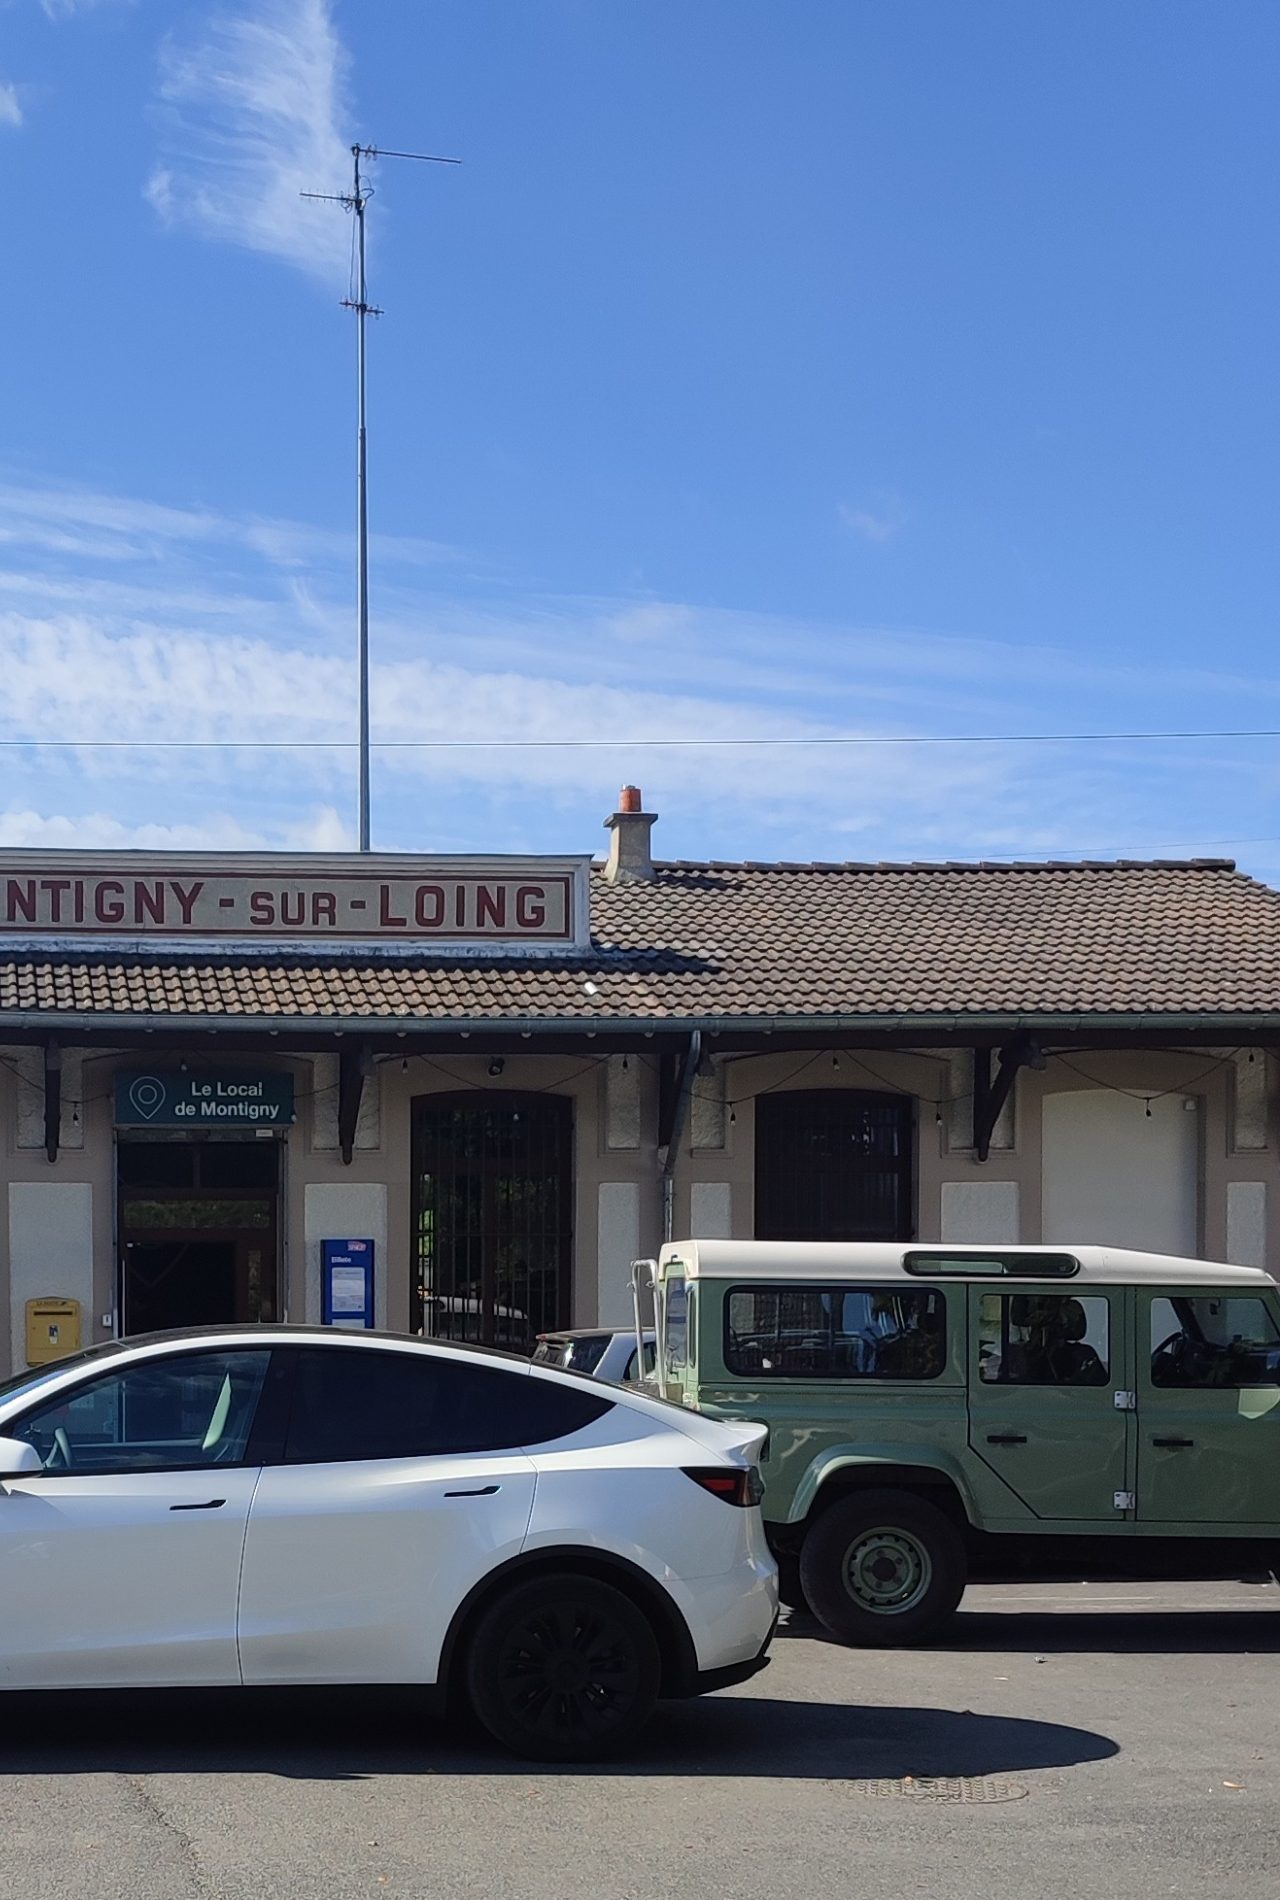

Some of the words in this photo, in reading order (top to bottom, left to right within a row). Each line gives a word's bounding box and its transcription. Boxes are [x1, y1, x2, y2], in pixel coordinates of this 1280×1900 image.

[192, 1082, 212, 1096] Le
[217, 1082, 263, 1096] Local
[175, 1101, 196, 1116] de
[201, 1101, 280, 1119] Montigny
